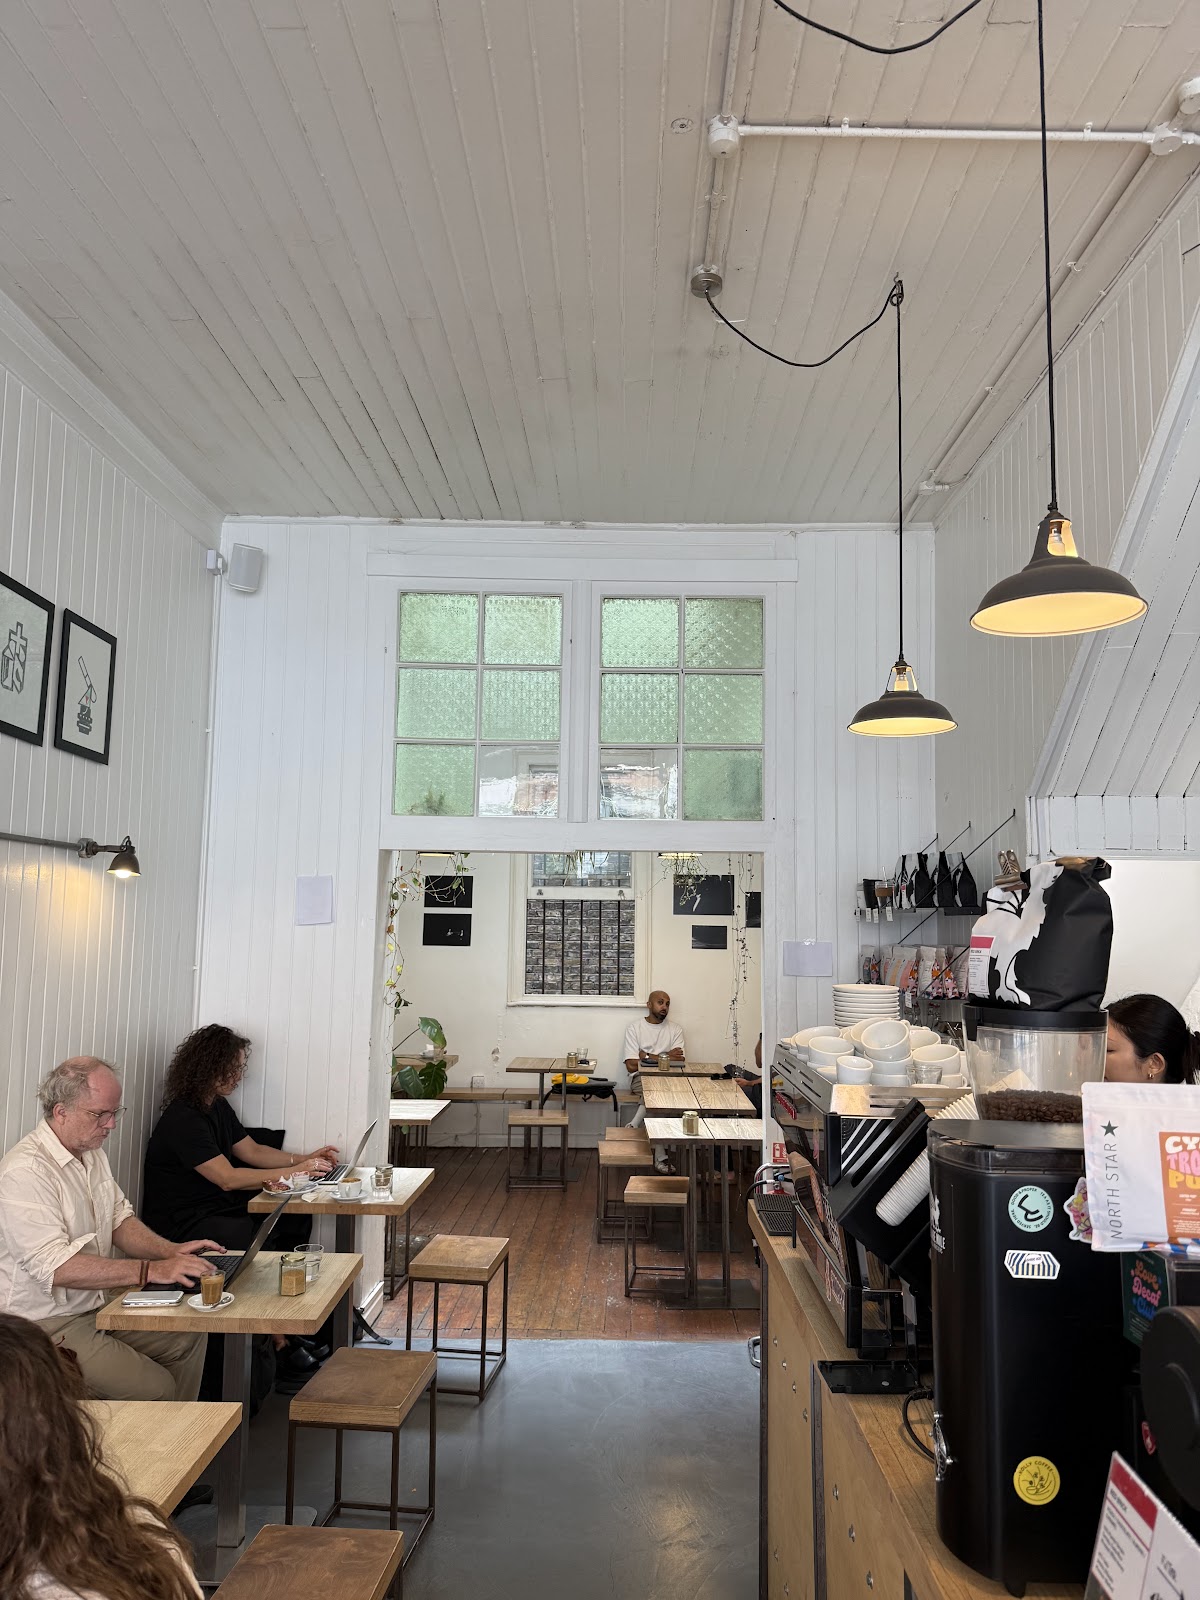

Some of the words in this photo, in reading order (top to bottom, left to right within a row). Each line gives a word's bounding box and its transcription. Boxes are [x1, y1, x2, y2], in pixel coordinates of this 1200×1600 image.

[1165, 1136, 1200, 1154] CY
[1103, 1143, 1120, 1182] STAR
[1106, 1188, 1123, 1240] NORTH
[1132, 1276, 1162, 1307] Decaf
[1034, 1460, 1053, 1473] COFFEE
